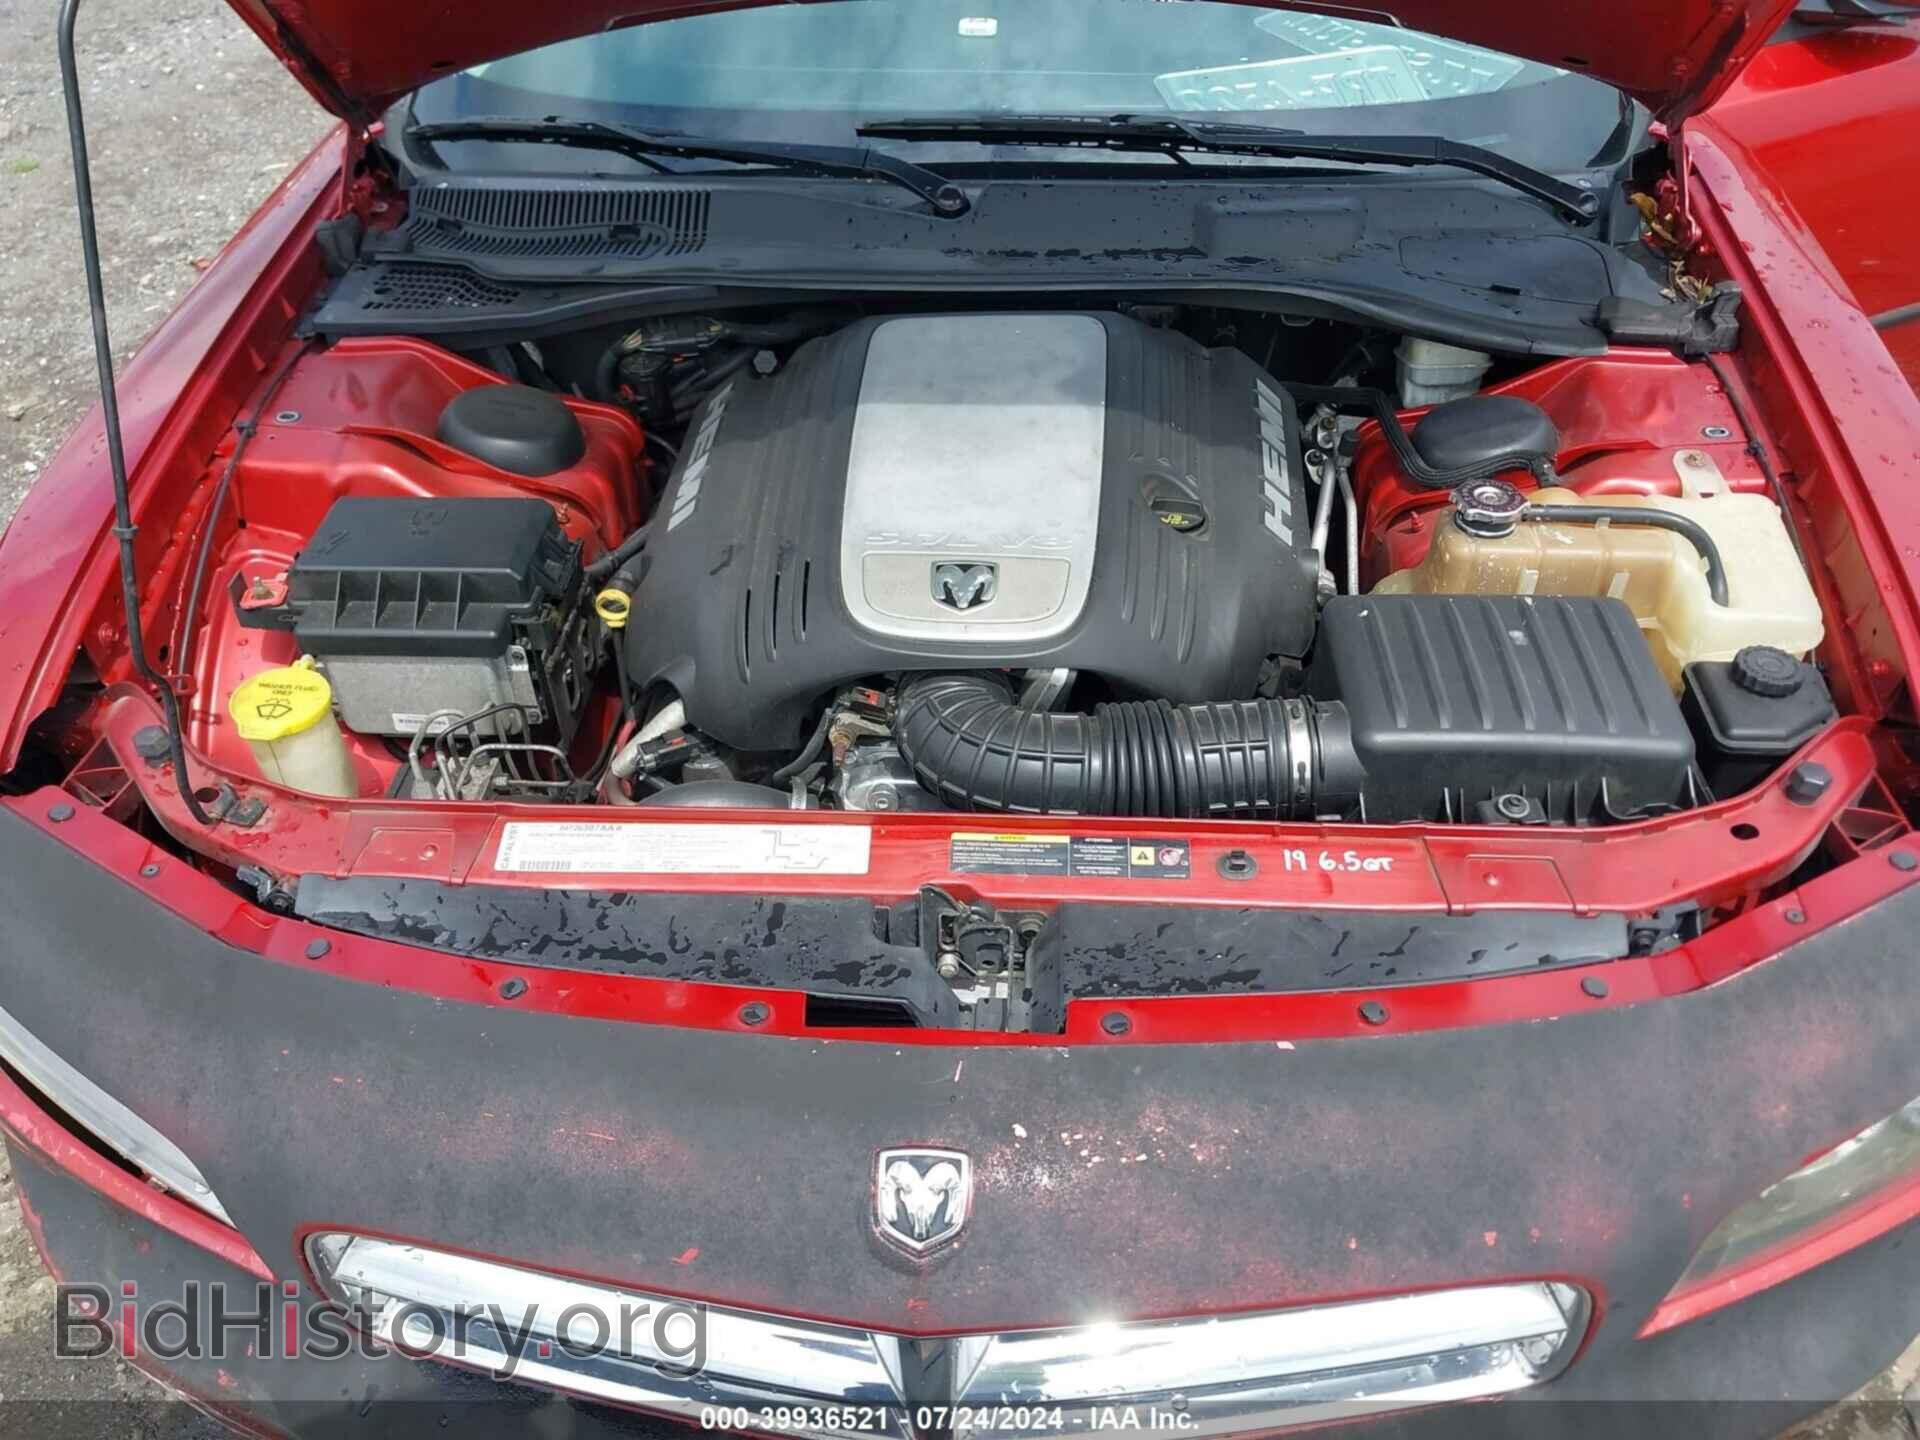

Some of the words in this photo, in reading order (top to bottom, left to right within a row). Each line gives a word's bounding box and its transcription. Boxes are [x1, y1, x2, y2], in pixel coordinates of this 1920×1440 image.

[667, 382, 733, 533] HEMI
[1256, 378, 1293, 547] HEMI
[1283, 848, 1308, 872] 19
